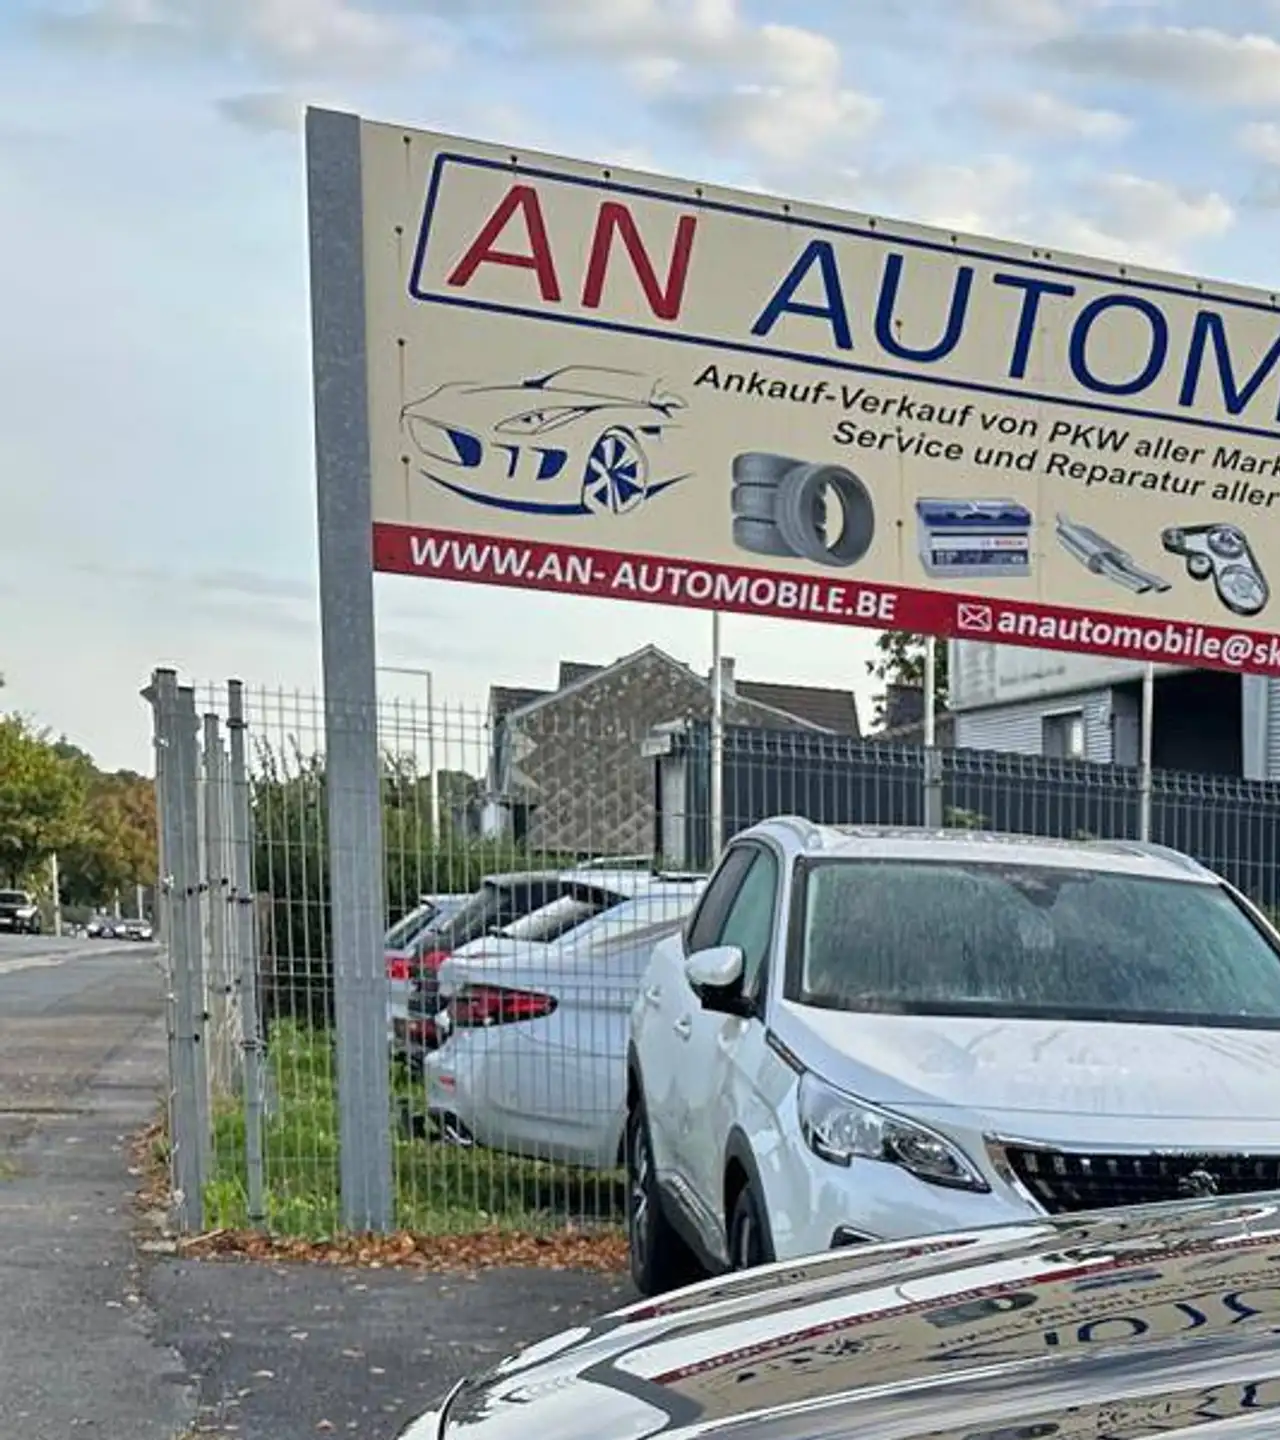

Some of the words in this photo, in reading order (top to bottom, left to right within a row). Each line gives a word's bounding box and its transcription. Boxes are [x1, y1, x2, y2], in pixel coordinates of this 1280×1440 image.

[446, 185, 697, 321] AN
[694, 364, 974, 427] Ankauf-Verkauf
[980, 412, 1038, 437] von
[1049, 420, 1130, 453] PKW
[1134, 436, 1206, 465] aller
[833, 420, 964, 461] Service
[974, 446, 1037, 472] und
[1046, 453, 1205, 497] Reparatur
[1212, 480, 1280, 508] aller
